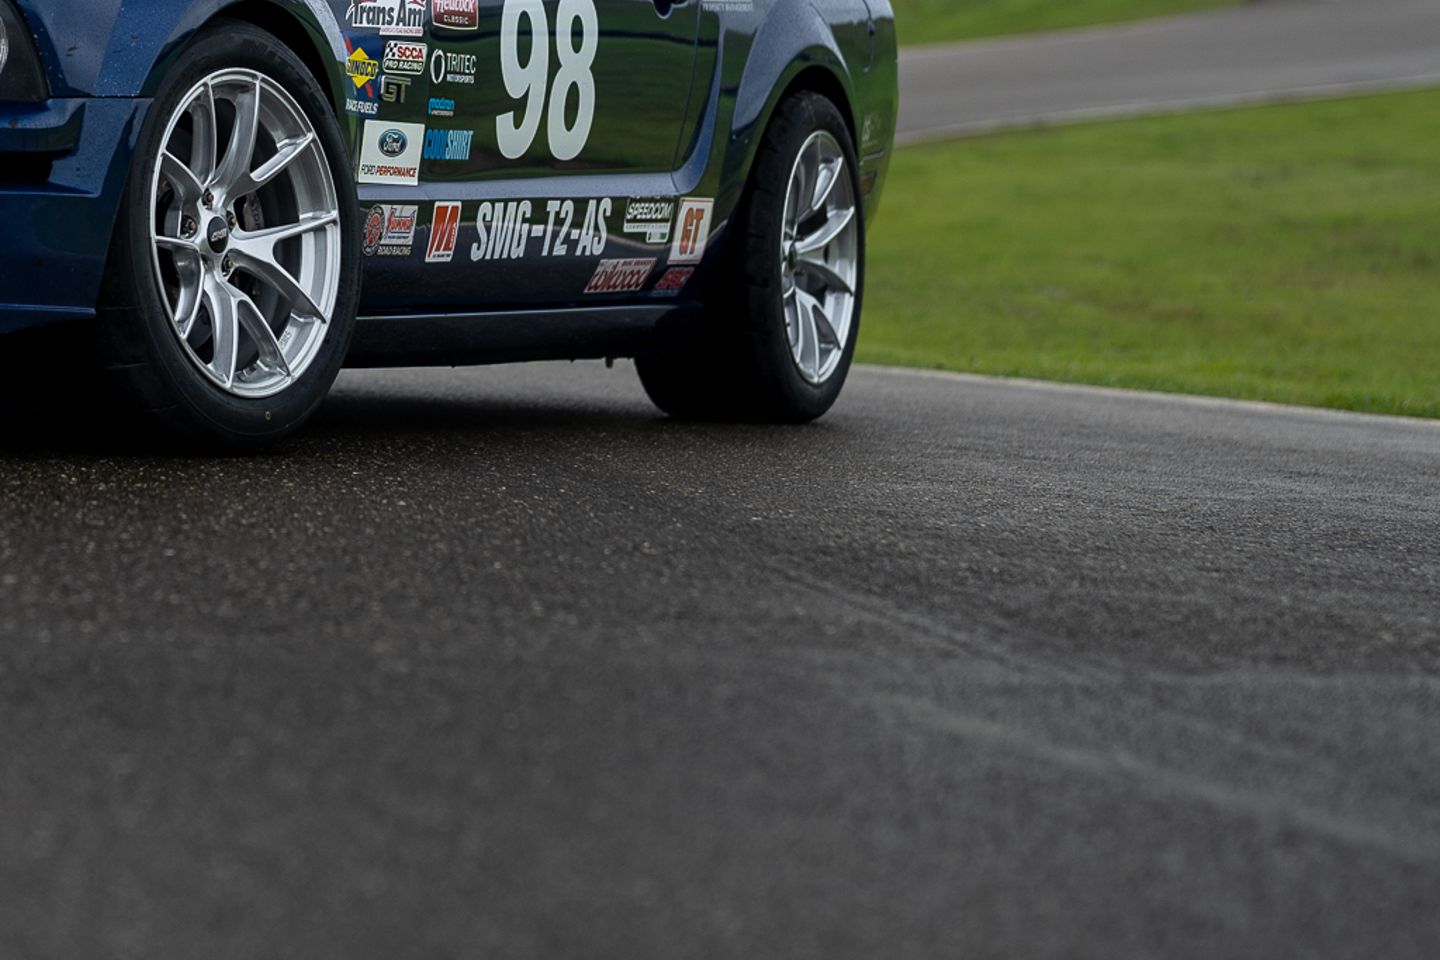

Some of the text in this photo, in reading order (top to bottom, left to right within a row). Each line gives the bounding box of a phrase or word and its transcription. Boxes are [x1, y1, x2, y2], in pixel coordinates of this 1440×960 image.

[397, 46, 425, 60] SCCA
[446, 52, 477, 74] TRITEC
[346, 59, 378, 79] SUNOCO
[383, 60, 424, 72] PRO RACING
[382, 132, 403, 153] Ford
[361, 163, 418, 178] FORD PERFORMANCE
[626, 202, 674, 220] SPEEDCOM
[470, 197, 612, 262] SMG-T2-AS
[679, 207, 705, 255] GT
